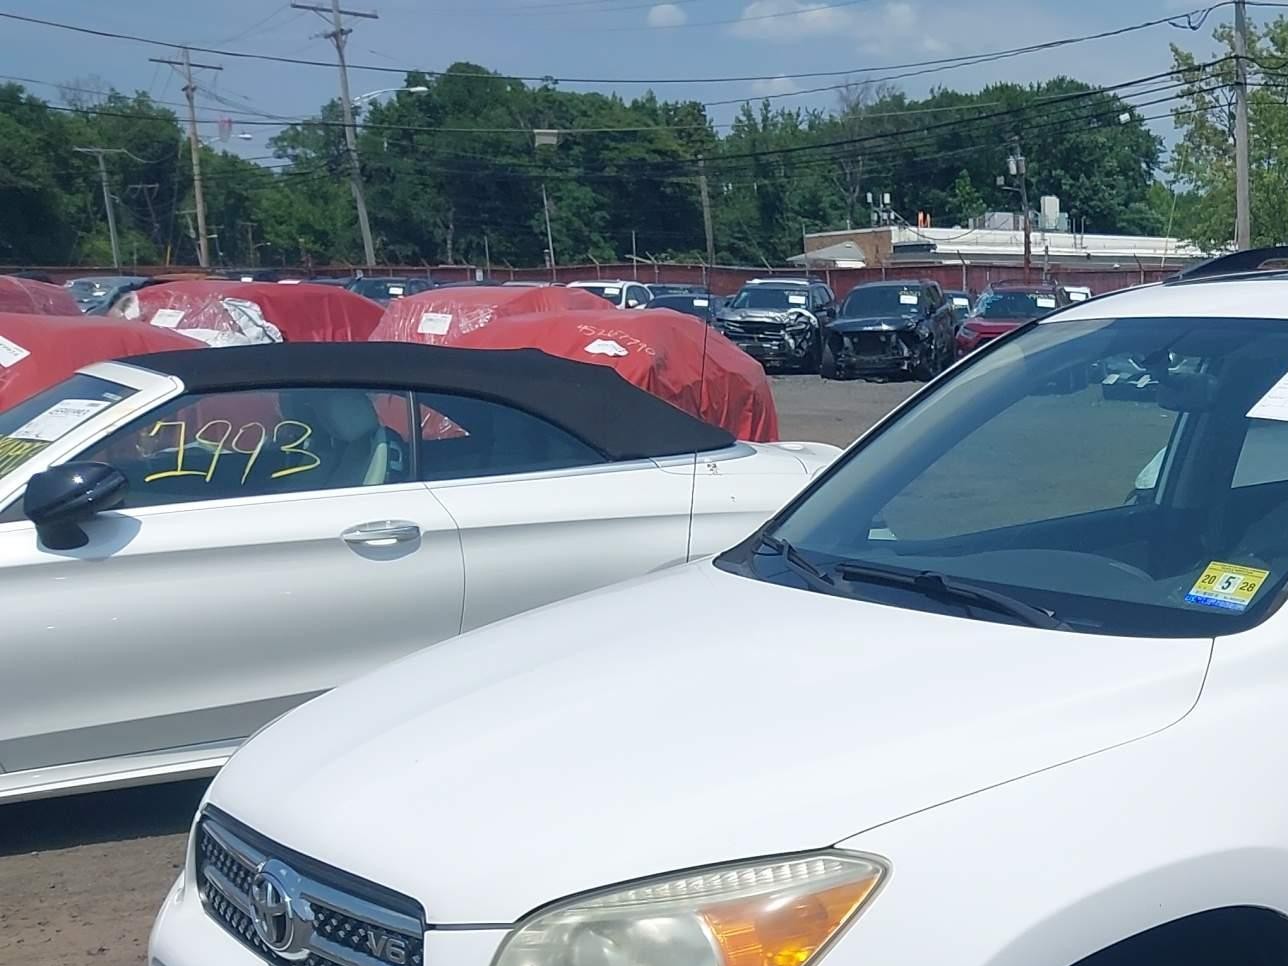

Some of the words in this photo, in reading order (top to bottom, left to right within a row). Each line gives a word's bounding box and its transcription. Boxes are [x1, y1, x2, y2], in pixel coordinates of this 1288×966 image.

[144, 419, 321, 485] 1993
[1201, 574, 1217, 585] 20
[1221, 575, 1236, 591] 5
[1239, 581, 1256, 593] 28
[367, 930, 405, 965] V6
